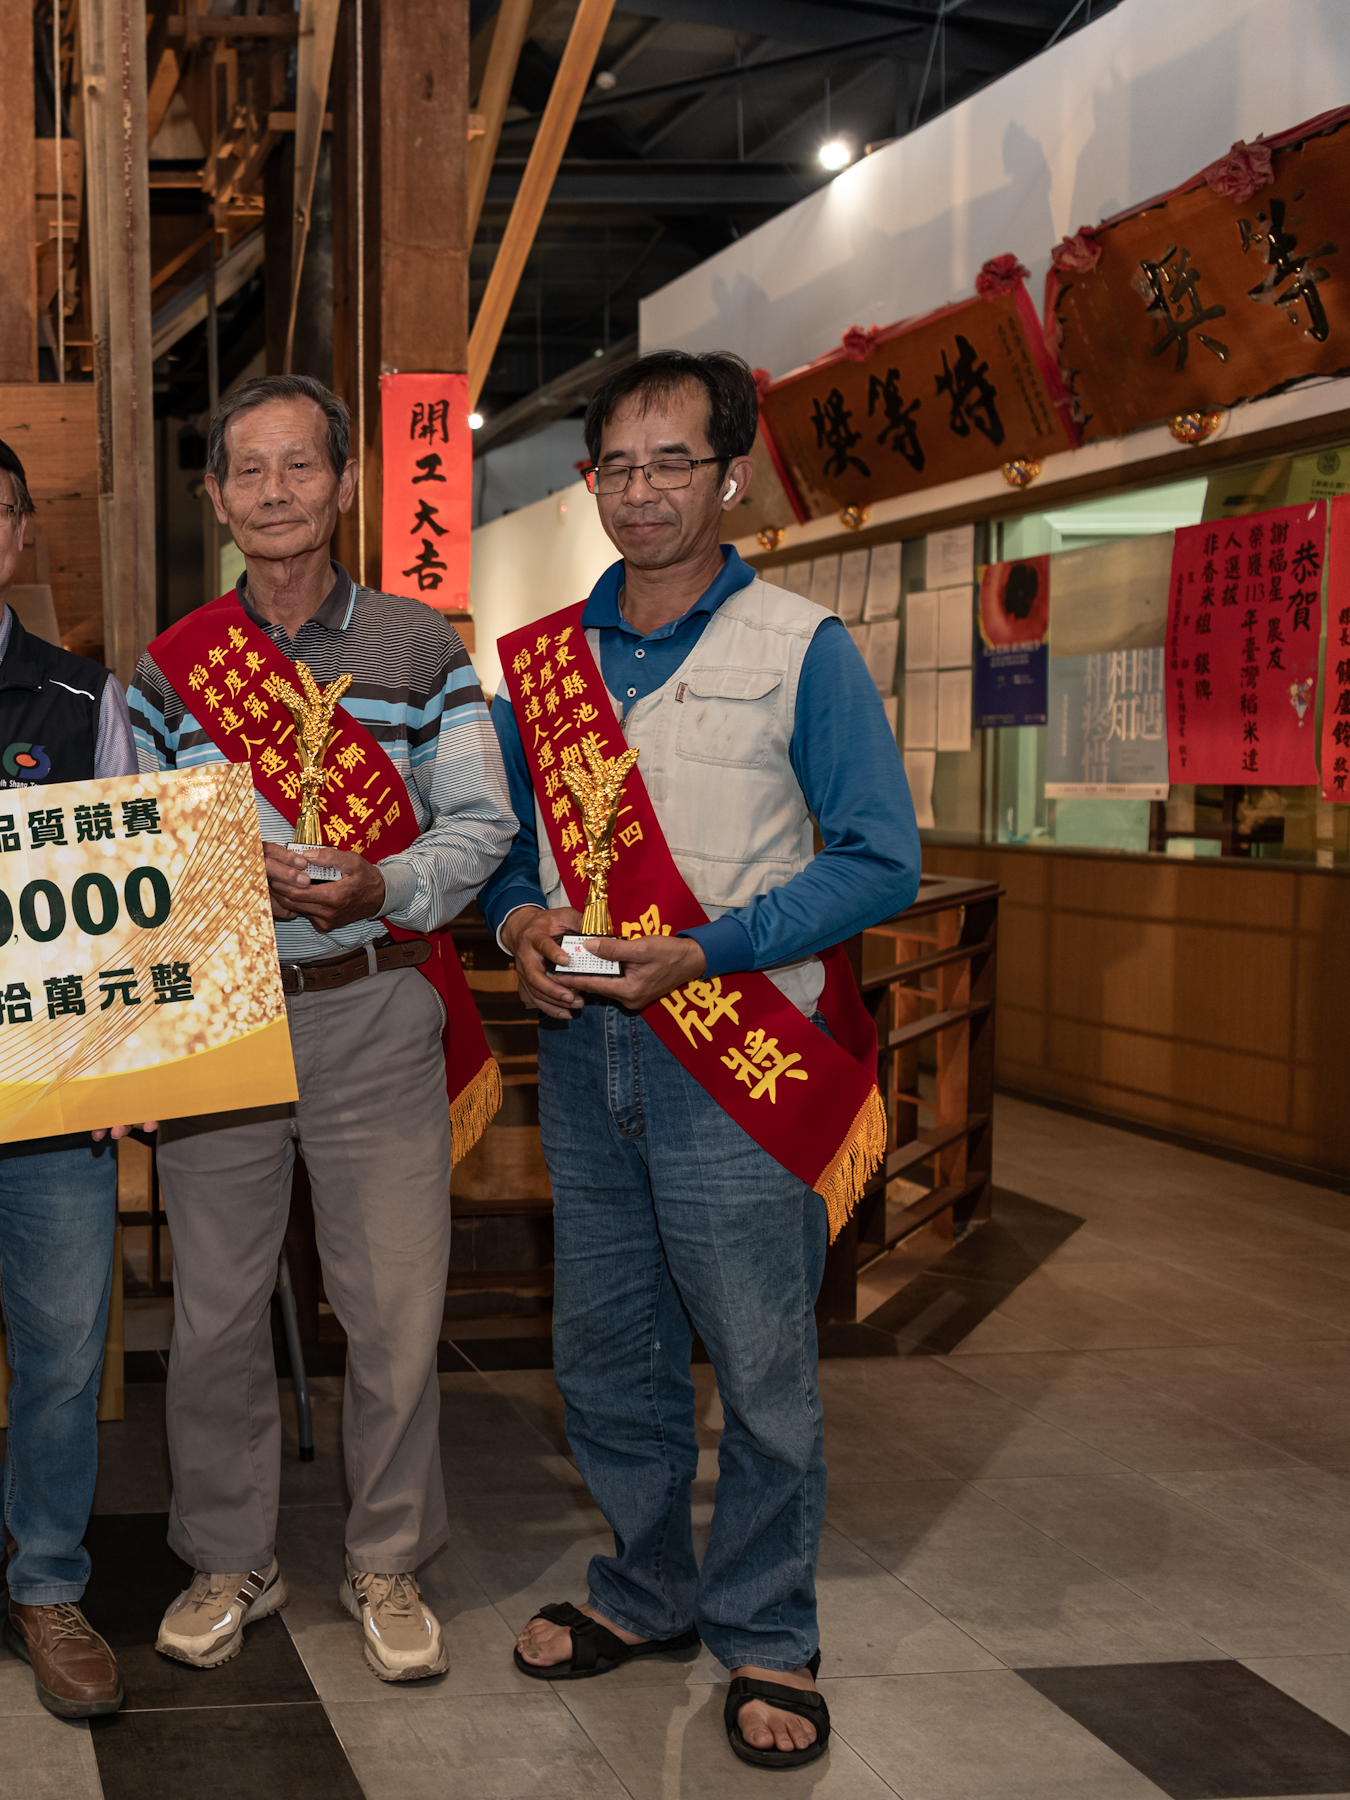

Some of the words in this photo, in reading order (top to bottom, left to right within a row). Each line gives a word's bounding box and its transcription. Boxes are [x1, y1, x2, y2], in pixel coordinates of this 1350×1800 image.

[402, 399, 450, 592] 開工大吉
[1287, 540, 1321, 632] 恭賀
